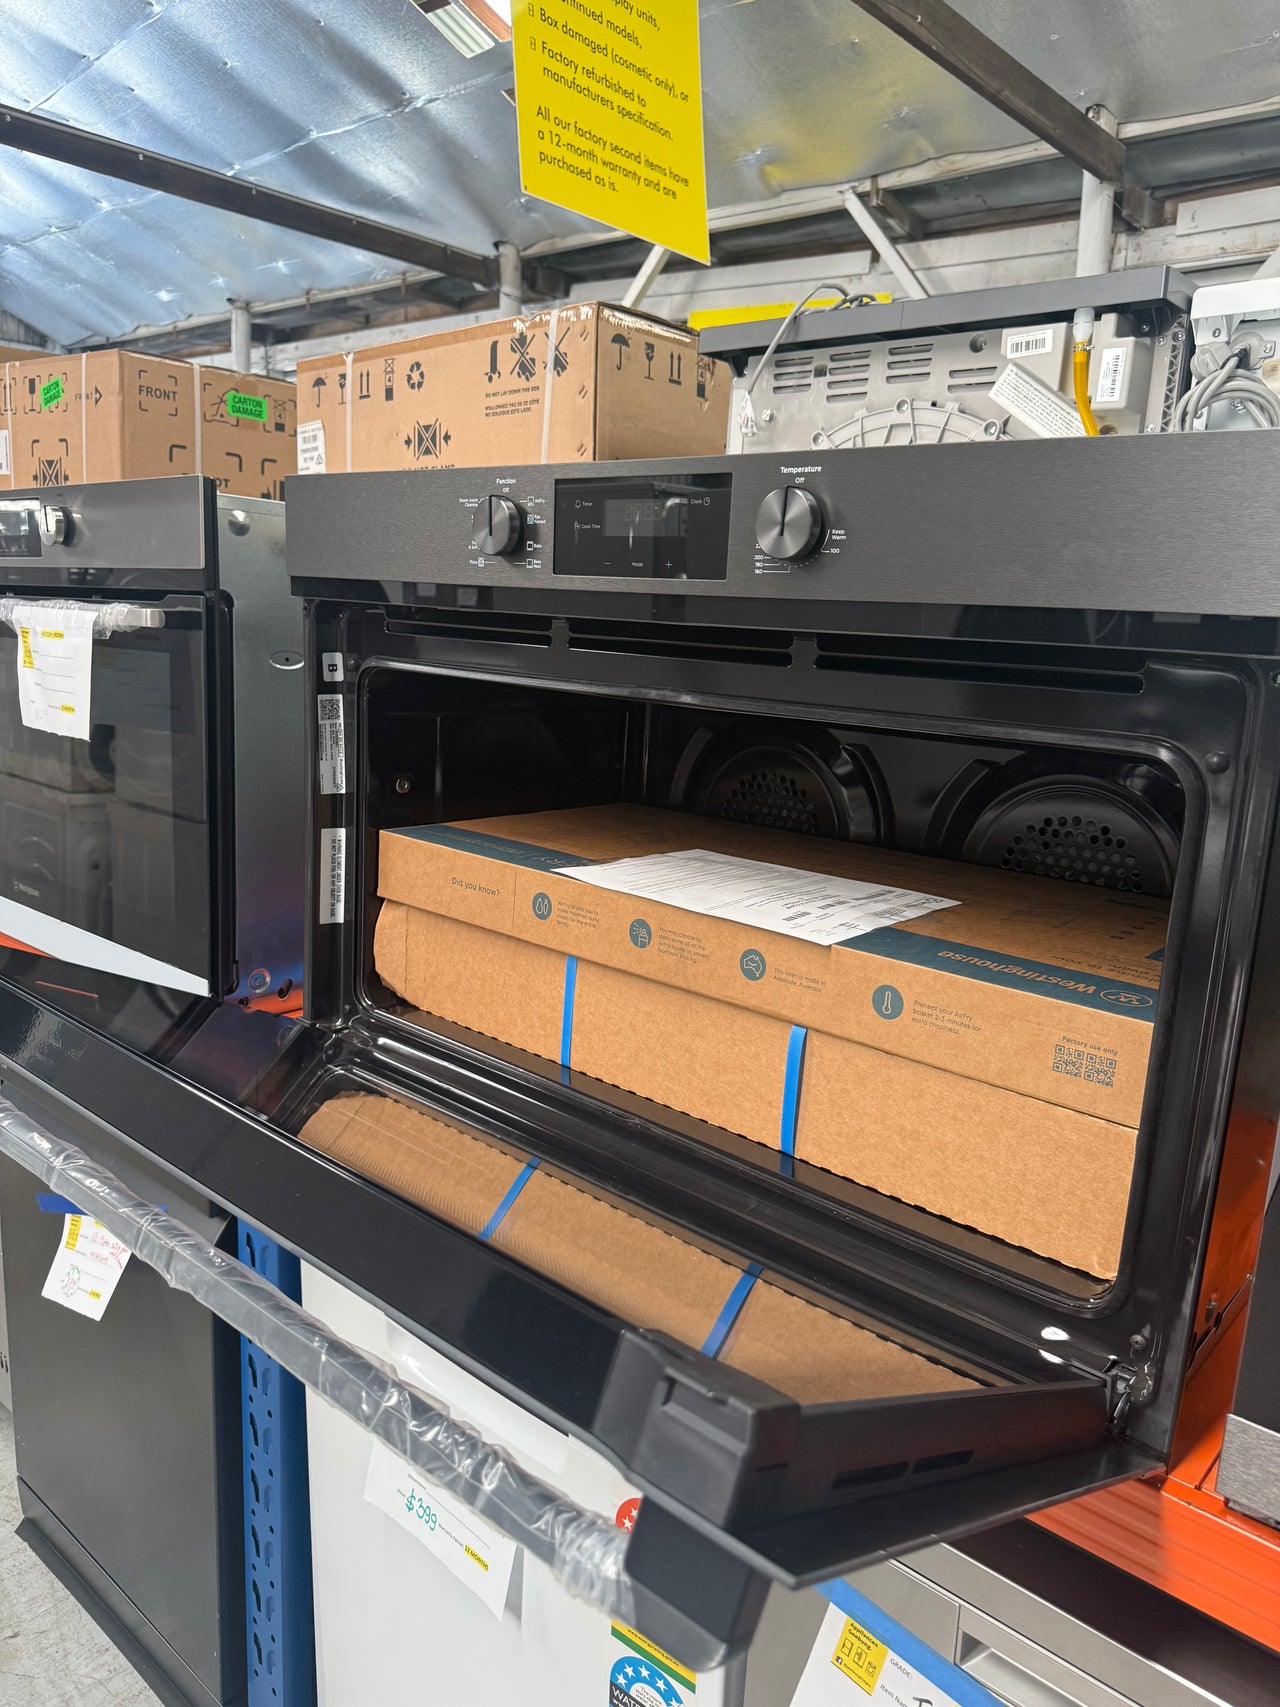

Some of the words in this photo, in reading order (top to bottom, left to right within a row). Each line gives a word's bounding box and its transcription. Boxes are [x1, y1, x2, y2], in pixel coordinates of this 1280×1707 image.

[636, 7, 660, 31] units,
[606, 20, 642, 50] models,
[540, 7, 559, 30] Box
[562, 21, 608, 57] damaged
[611, 48, 652, 82] (cosmetic
[680, 92, 689, 102] or
[542, 41, 578, 74] Factory
[582, 67, 634, 101] refurbished
[637, 93, 646, 108] to
[543, 67, 615, 111] manufacturers
[617, 104, 673, 141] specification.
[537, 105, 550, 122] All
[554, 116, 571, 131] our
[574, 121, 607, 151] factory
[609, 142, 641, 164] second
[644, 154, 667, 177] items
[669, 166, 689, 187] have
[538, 129, 545, 140] a
[549, 130, 598, 164] 12-month
[601, 158, 642, 186] warranty
[644, 177, 660, 192] and
[663, 186, 677, 200] are
[539, 150, 592, 181] purchased
[595, 174, 606, 187] as
[608, 176, 619, 193] is.
[138, 385, 177, 401] FRONT
[232, 394, 263, 409] CARTON
[232, 404, 264, 419] DAMAGE
[780, 466, 822, 474] Temperature
[328, 663, 338, 673] B
[452, 877, 463, 886] Did
[464, 882, 477, 891] you
[478, 884, 500, 897] know?
[937, 951, 1097, 995] Westinghouse
[913, 999, 938, 1011] Preheat
[938, 1008, 954, 1016] your
[911, 1017, 928, 1026] extra
[913, 1008, 934, 1019] basket
[946, 1018, 971, 1030] minutes
[971, 1024, 982, 1032] for
[1062, 1035, 1088, 1048] Factory
[1103, 1047, 1118, 1056] only
[405, 1488, 438, 1531] $399
[850, 1623, 879, 1648] Appliances
[890, 1658, 913, 1680] GRADE:
[612, 1686, 639, 1707] WAT
[880, 1683, 894, 1698] Item
